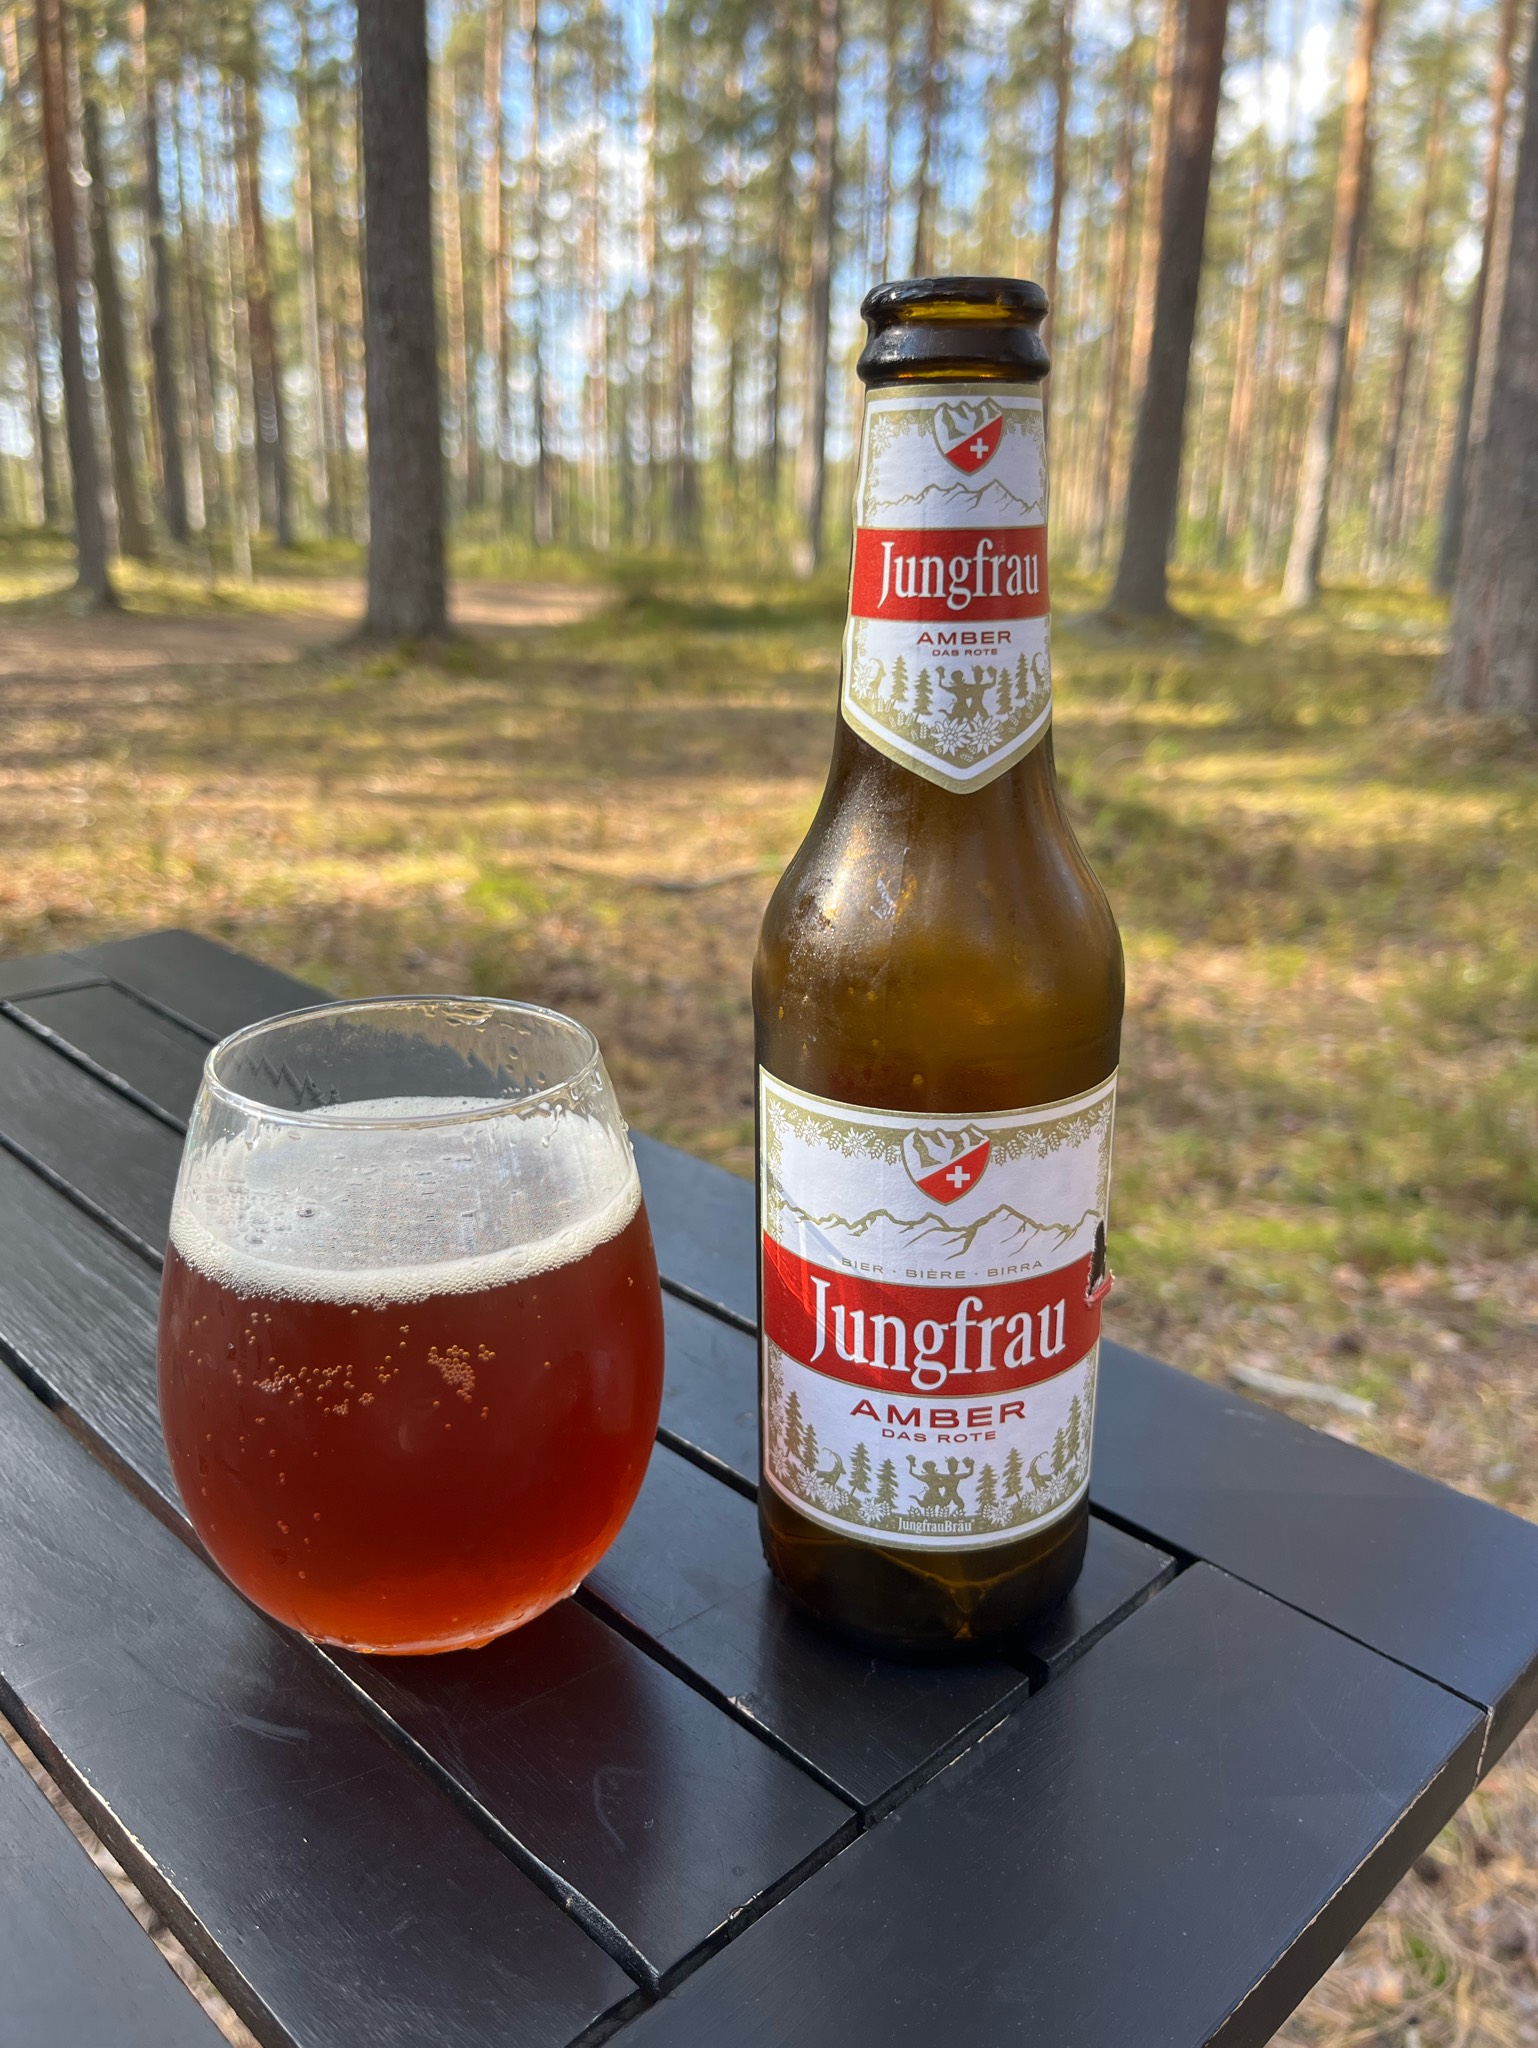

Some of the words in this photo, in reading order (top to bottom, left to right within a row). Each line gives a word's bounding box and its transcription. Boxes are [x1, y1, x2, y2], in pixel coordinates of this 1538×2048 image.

[877, 537, 1040, 611] Jungfrau
[917, 631, 1012, 645] AMBER
[932, 649, 960, 657] DAS
[964, 648, 998, 657] ROTE
[841, 1257, 884, 1274] BIER
[905, 1268, 966, 1280] BIÈRE
[987, 1259, 1043, 1277] BIRRA
[809, 1275, 1067, 1391] Jungfrau
[849, 1398, 1026, 1429] AMBER
[882, 1428, 927, 1443] DAS
[937, 1430, 997, 1444] ROTE
